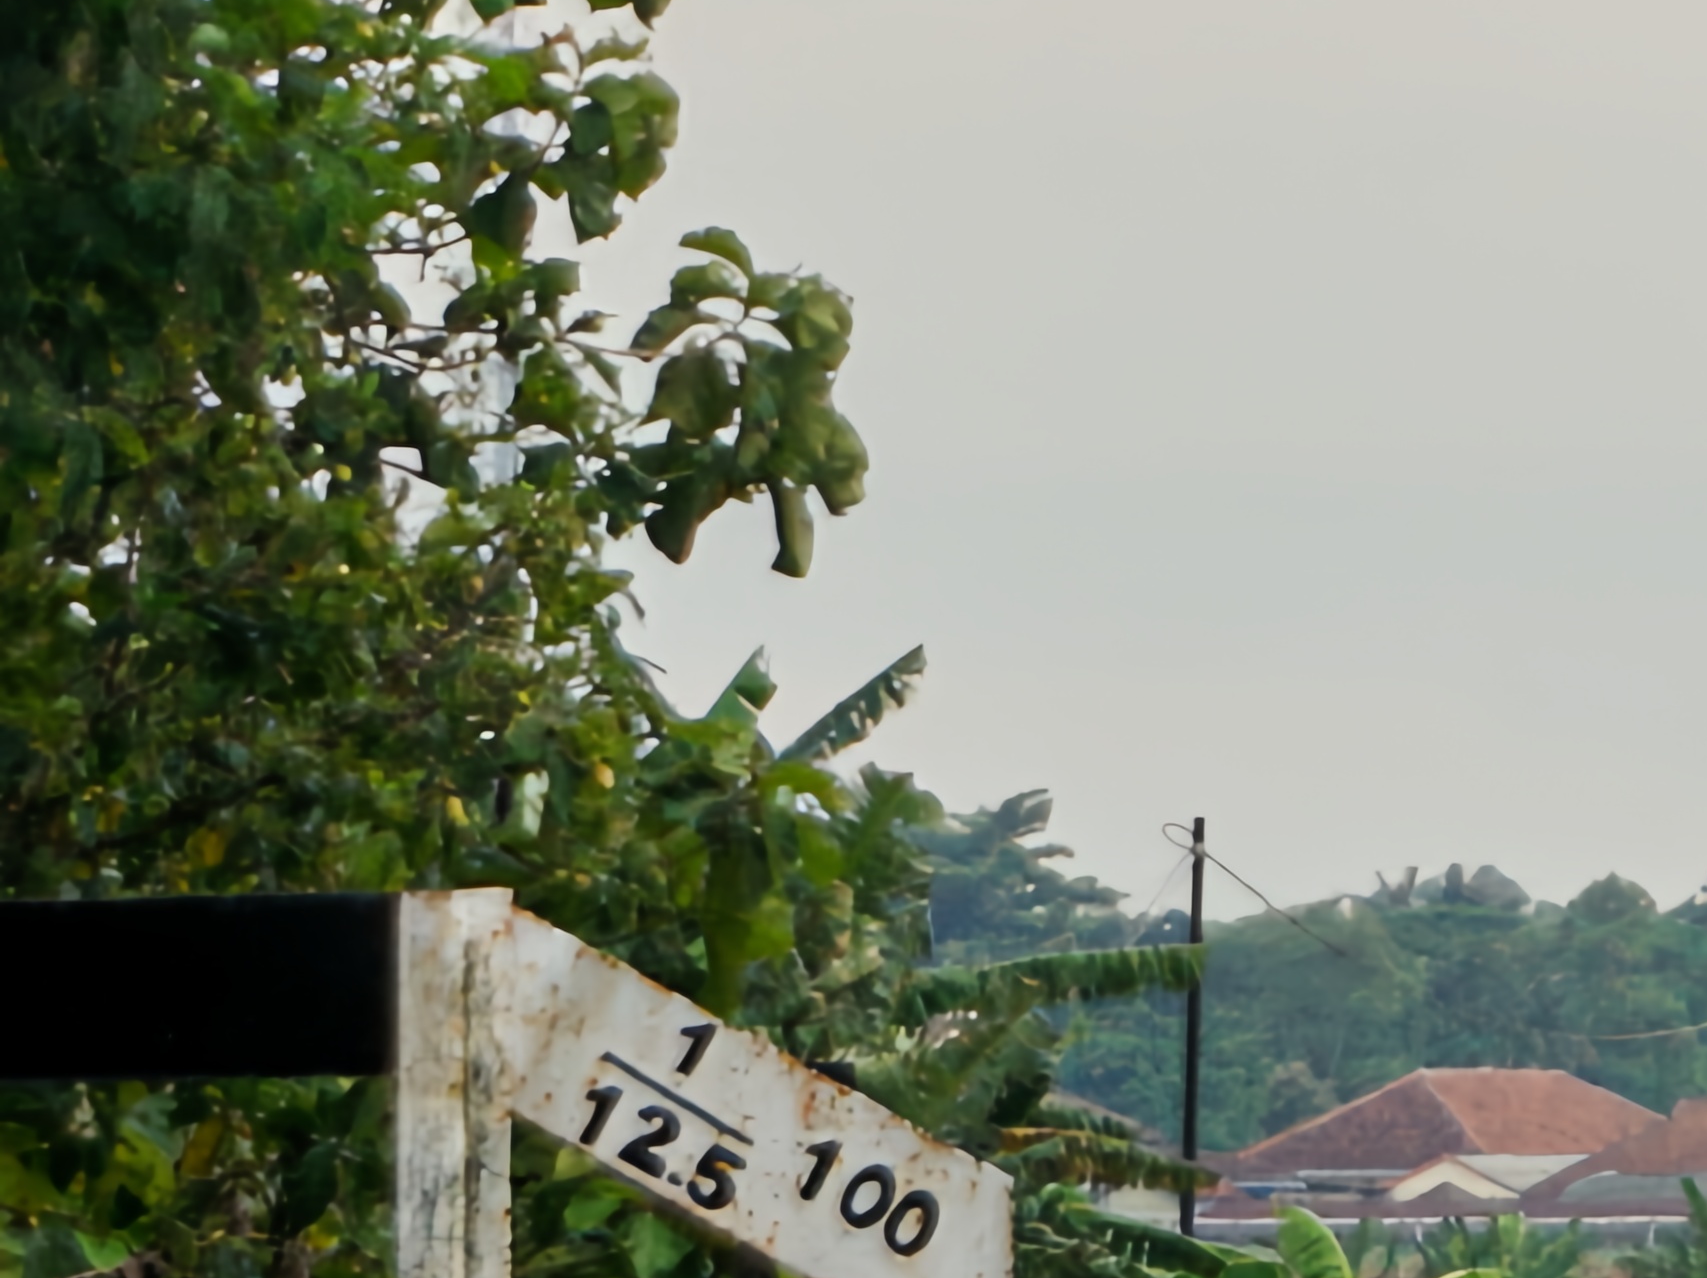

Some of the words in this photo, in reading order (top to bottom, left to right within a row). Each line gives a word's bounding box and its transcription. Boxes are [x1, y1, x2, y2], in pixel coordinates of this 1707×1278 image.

[677, 1023, 717, 1076] 1
[579, 1086, 747, 1210] 12.5
[800, 1140, 940, 1257] 100
